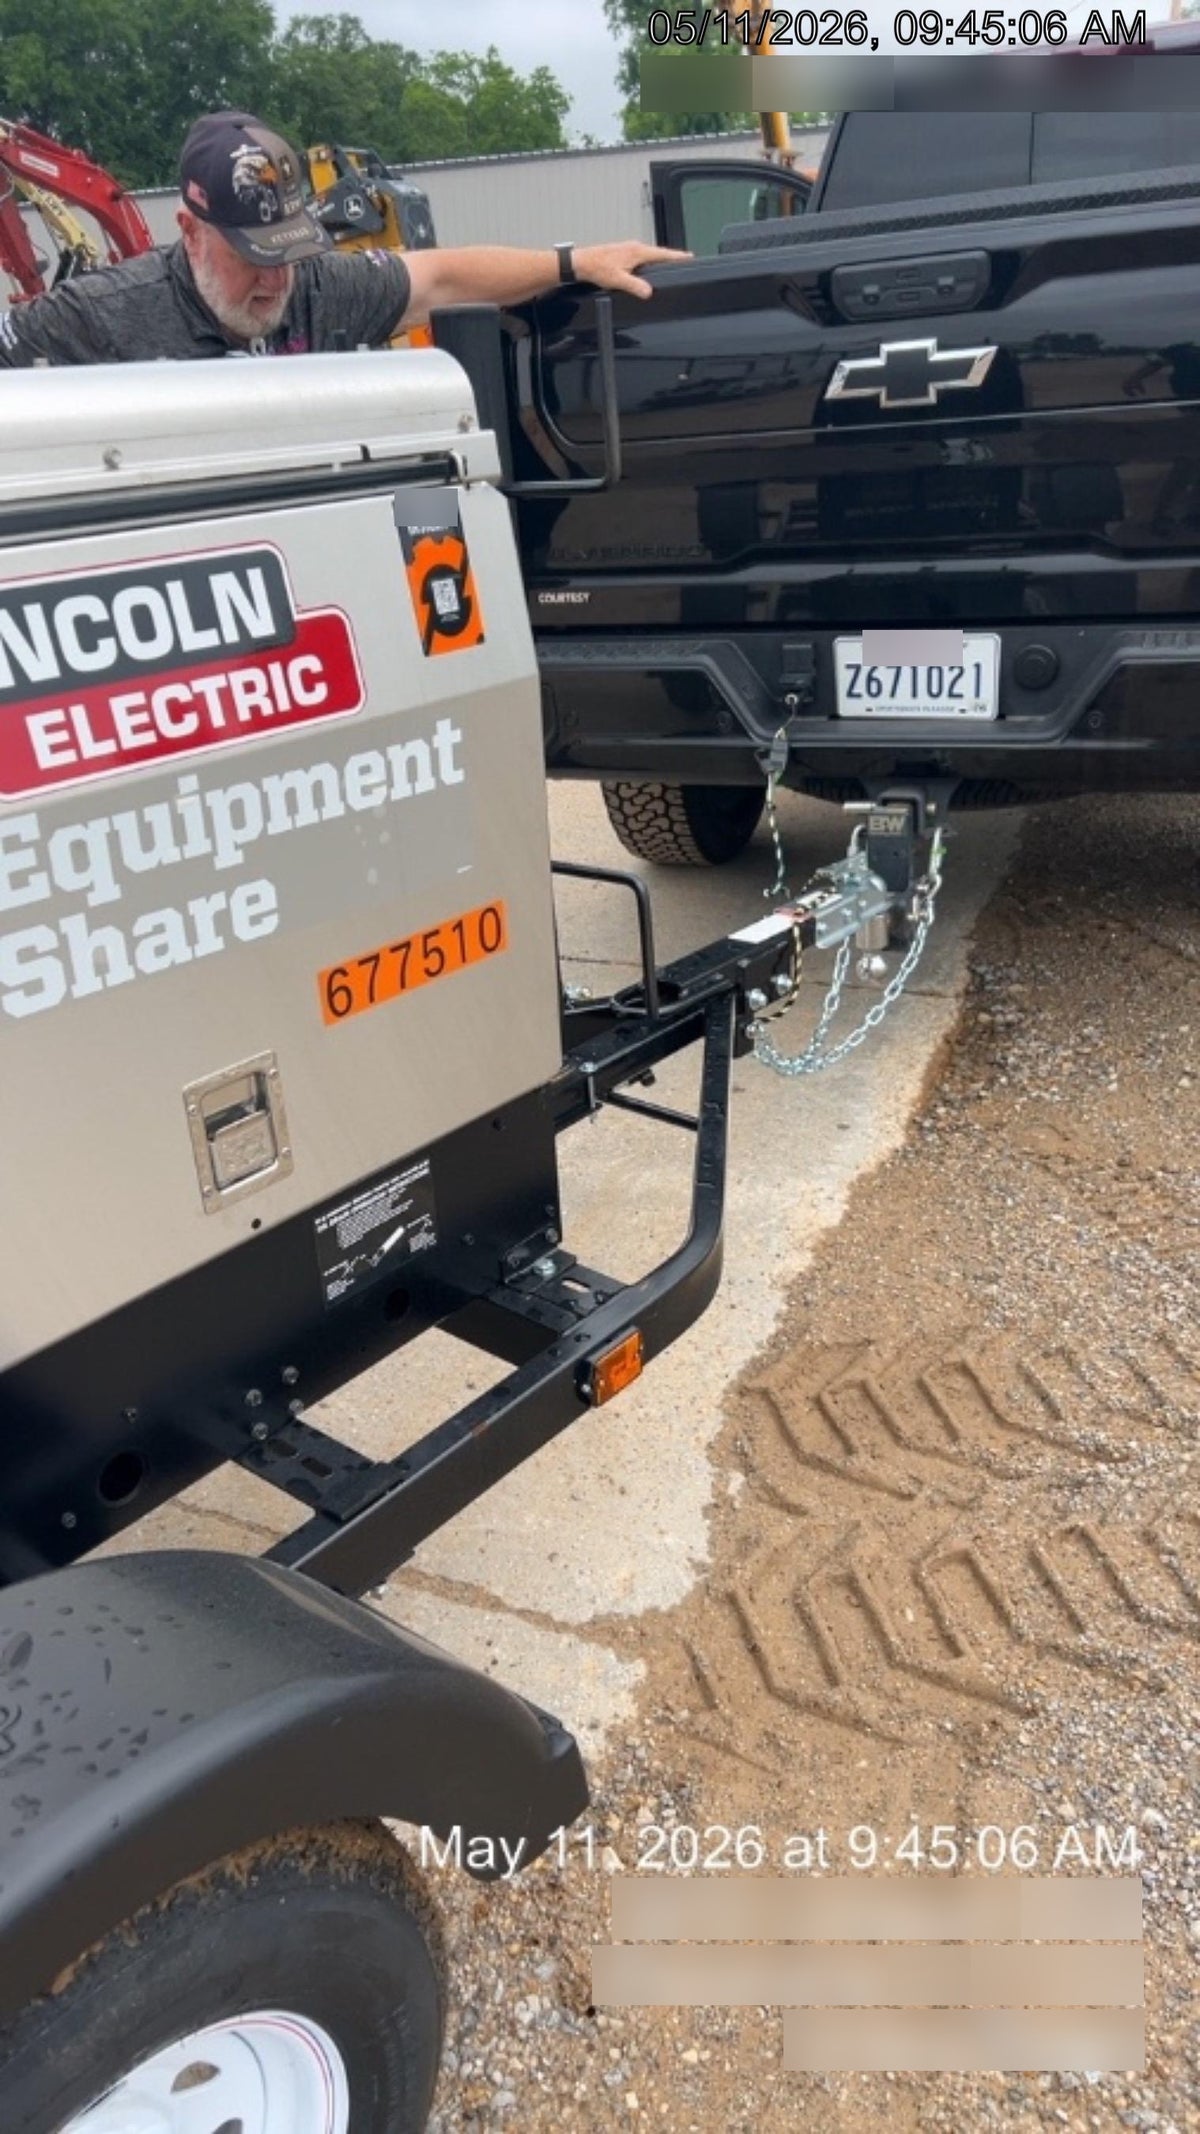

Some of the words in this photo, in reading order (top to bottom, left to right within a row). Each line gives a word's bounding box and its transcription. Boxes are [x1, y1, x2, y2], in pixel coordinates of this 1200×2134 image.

[25, 653, 329, 770] ELECTRIC
[845, 661, 981, 699] Z671021
[0, 718, 465, 911] Equipment
[0, 878, 279, 1018] Share
[326, 906, 502, 1018] 677510
